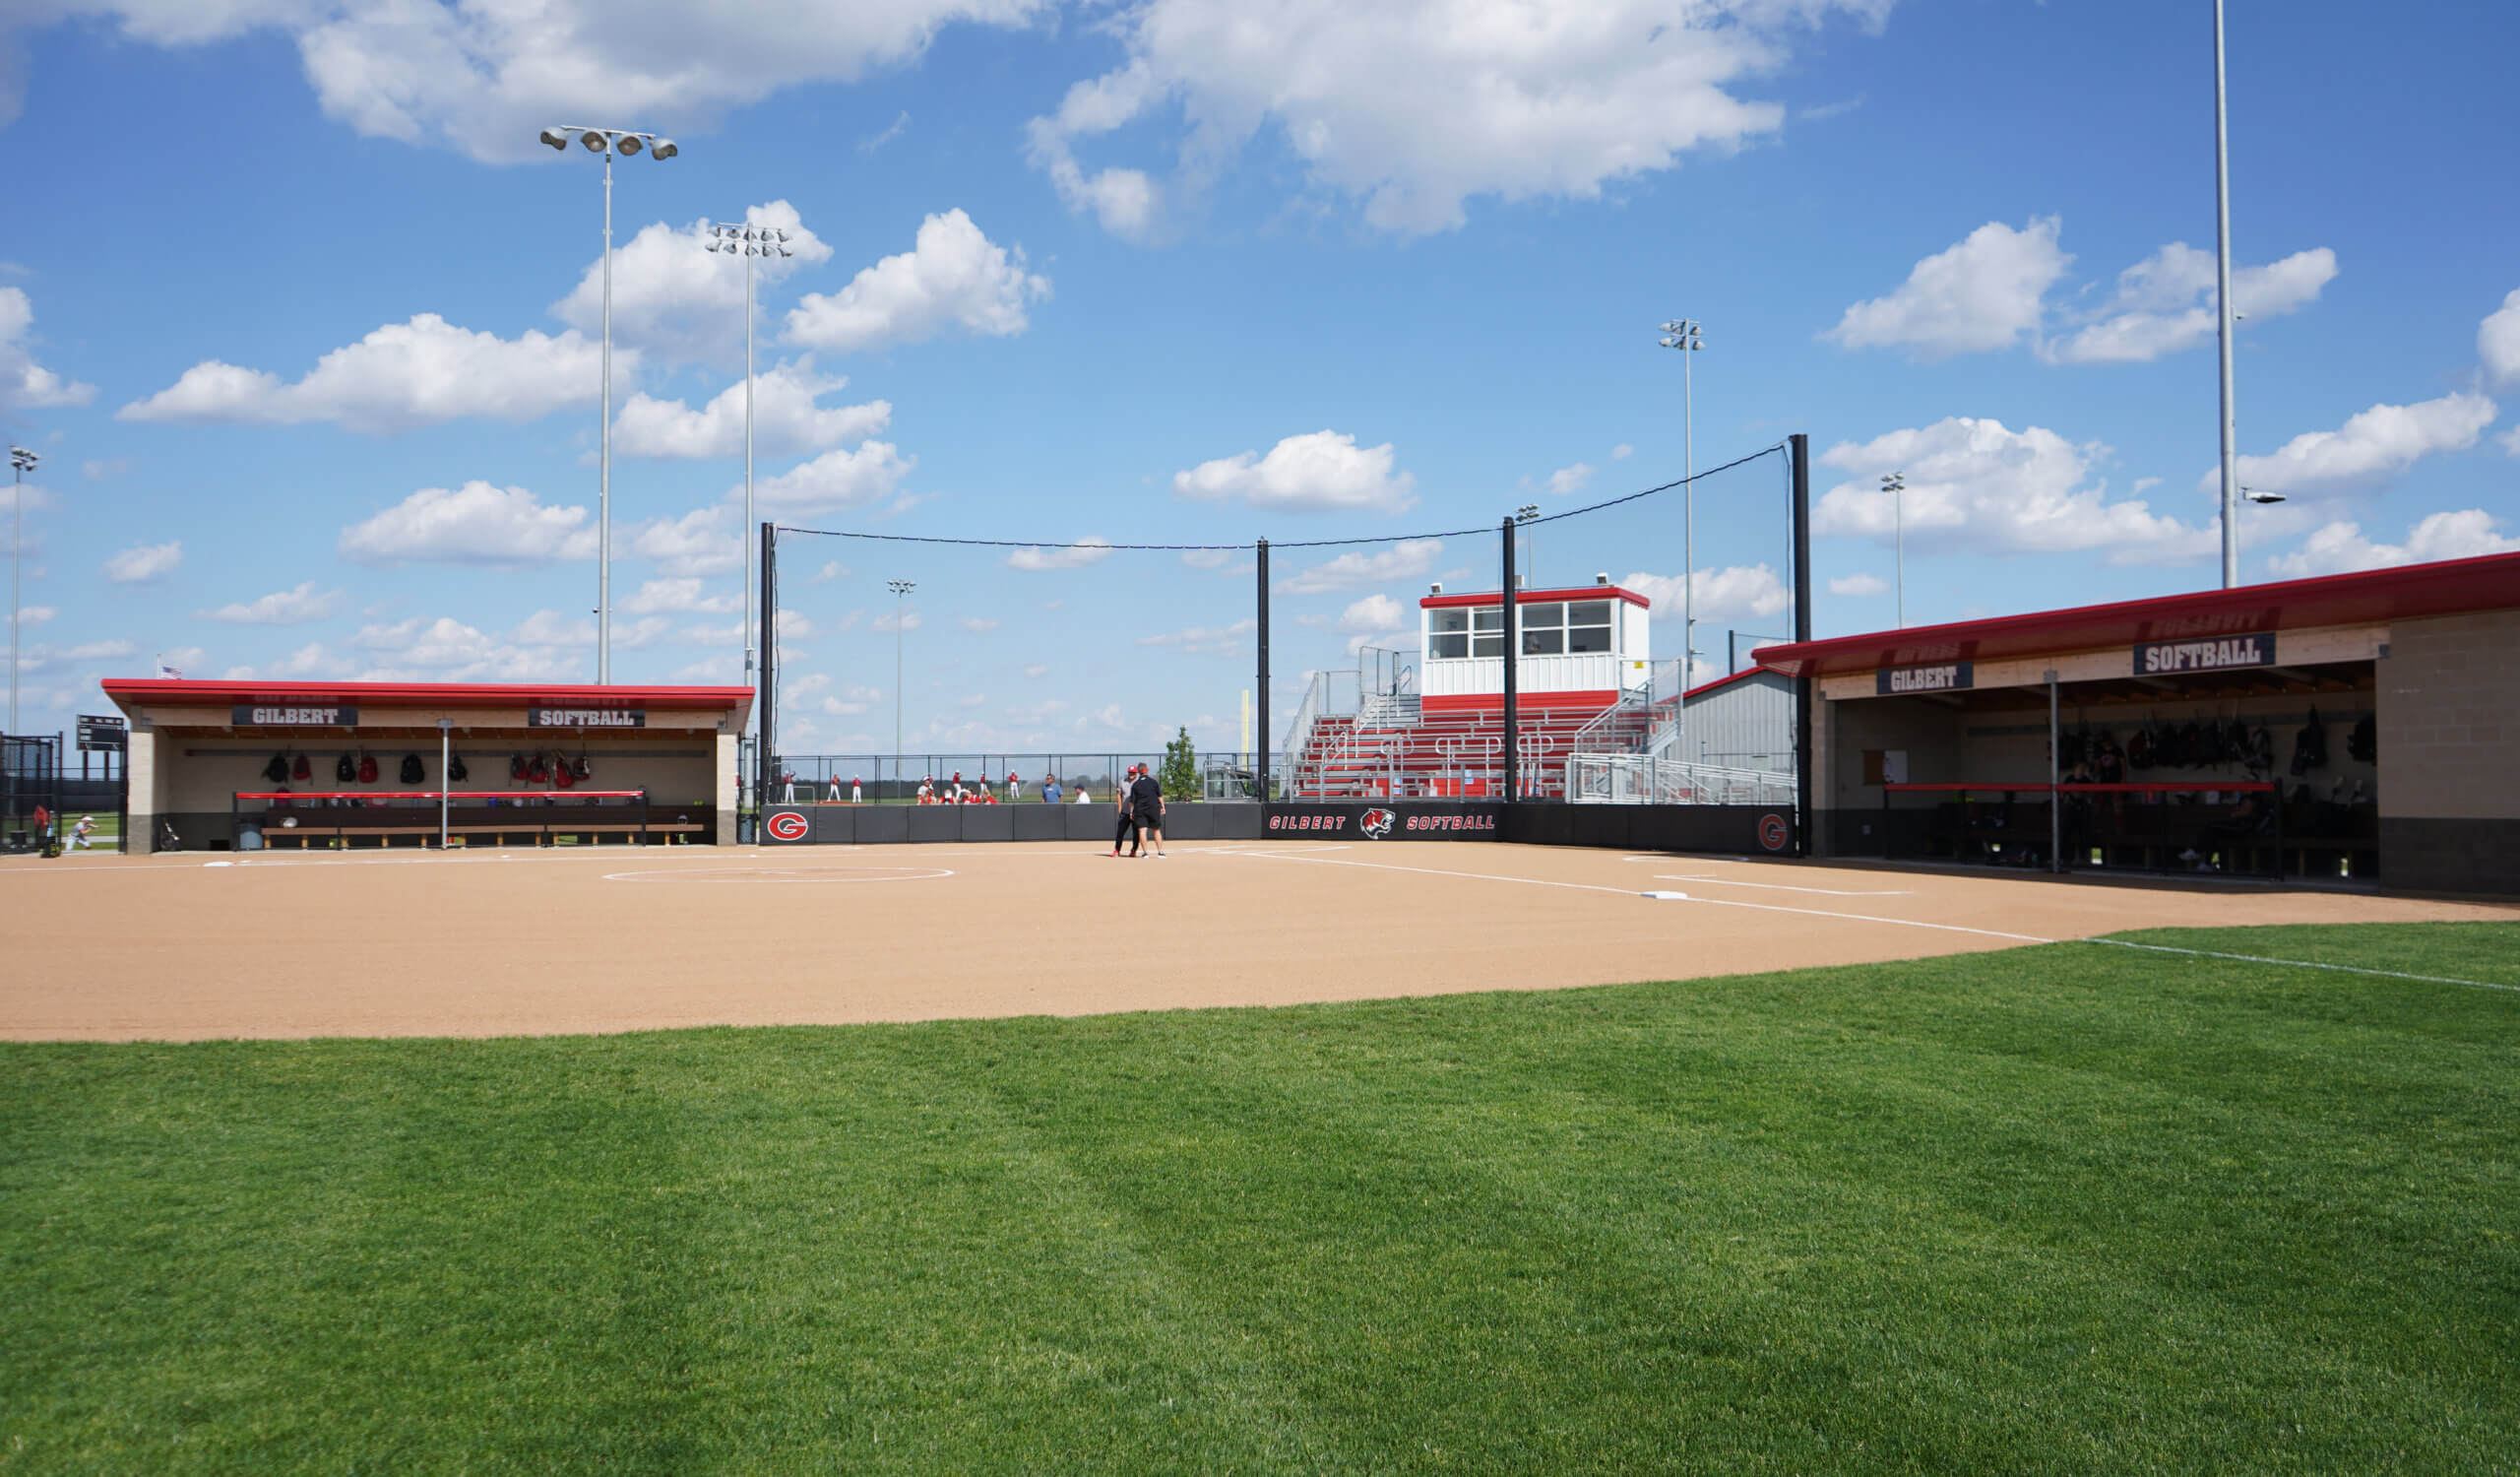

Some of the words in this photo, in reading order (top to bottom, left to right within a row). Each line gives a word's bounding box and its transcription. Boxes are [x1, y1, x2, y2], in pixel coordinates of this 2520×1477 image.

[2145, 638, 2261, 672] SOFTBALL
[1890, 666, 1958, 692] GILBERT
[252, 708, 339, 725] GILBERT
[539, 709, 635, 726] SOFTBALL
[767, 811, 808, 841] G
[1269, 815, 1347, 830] GILBERT
[1406, 815, 1495, 830] SOFTBALL
[1758, 813, 1788, 851] G
